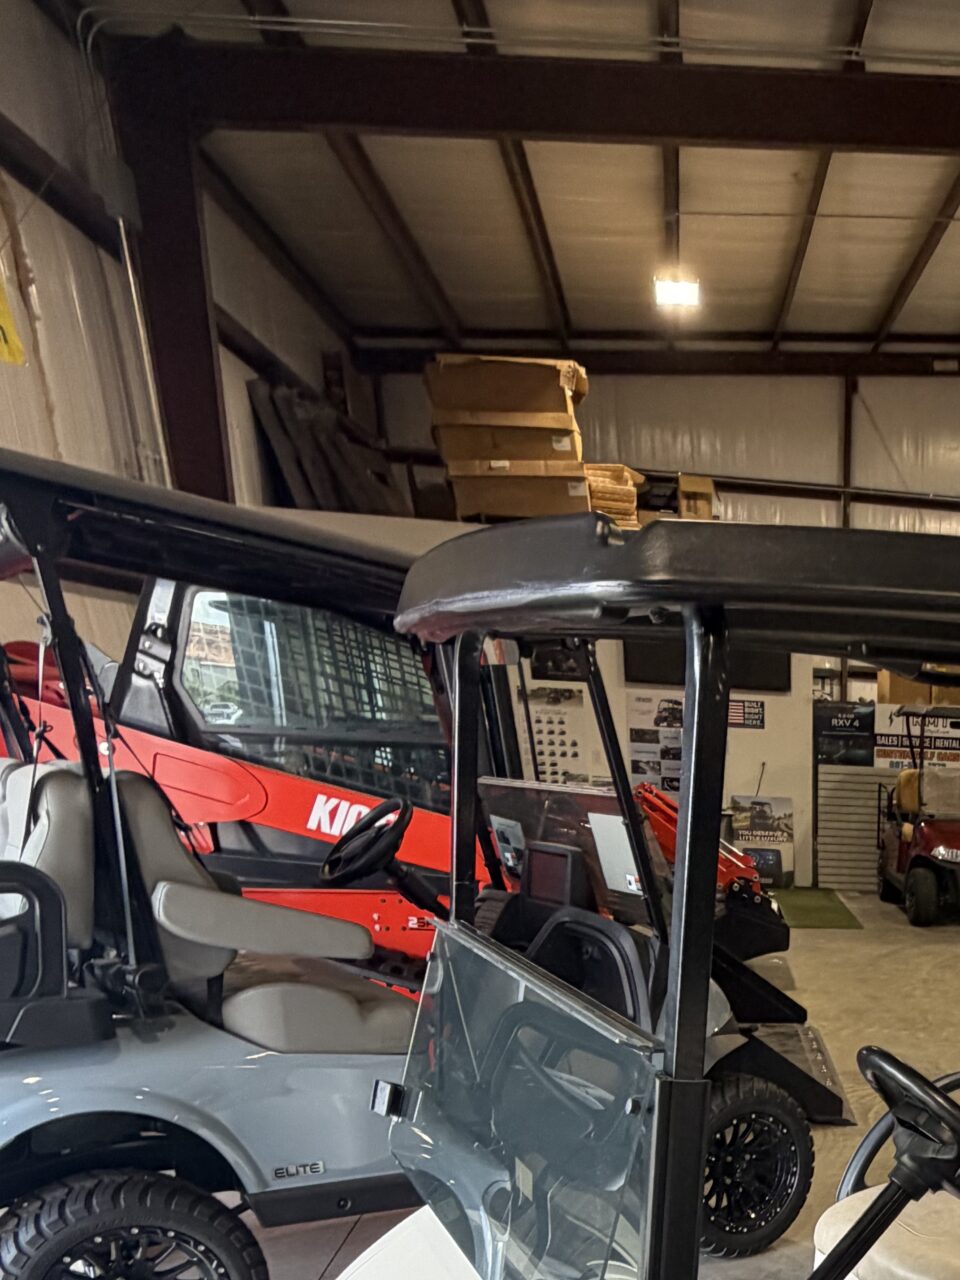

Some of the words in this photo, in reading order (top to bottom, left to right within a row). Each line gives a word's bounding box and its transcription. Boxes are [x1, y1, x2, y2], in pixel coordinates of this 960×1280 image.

[831, 718, 851, 727] RXV
[853, 719, 860, 727] 4
[876, 735, 898, 745] SALES
[935, 739, 960, 749] RENTAL
[306, 793, 400, 838] KIO
[274, 1162, 321, 1178] ELITE
